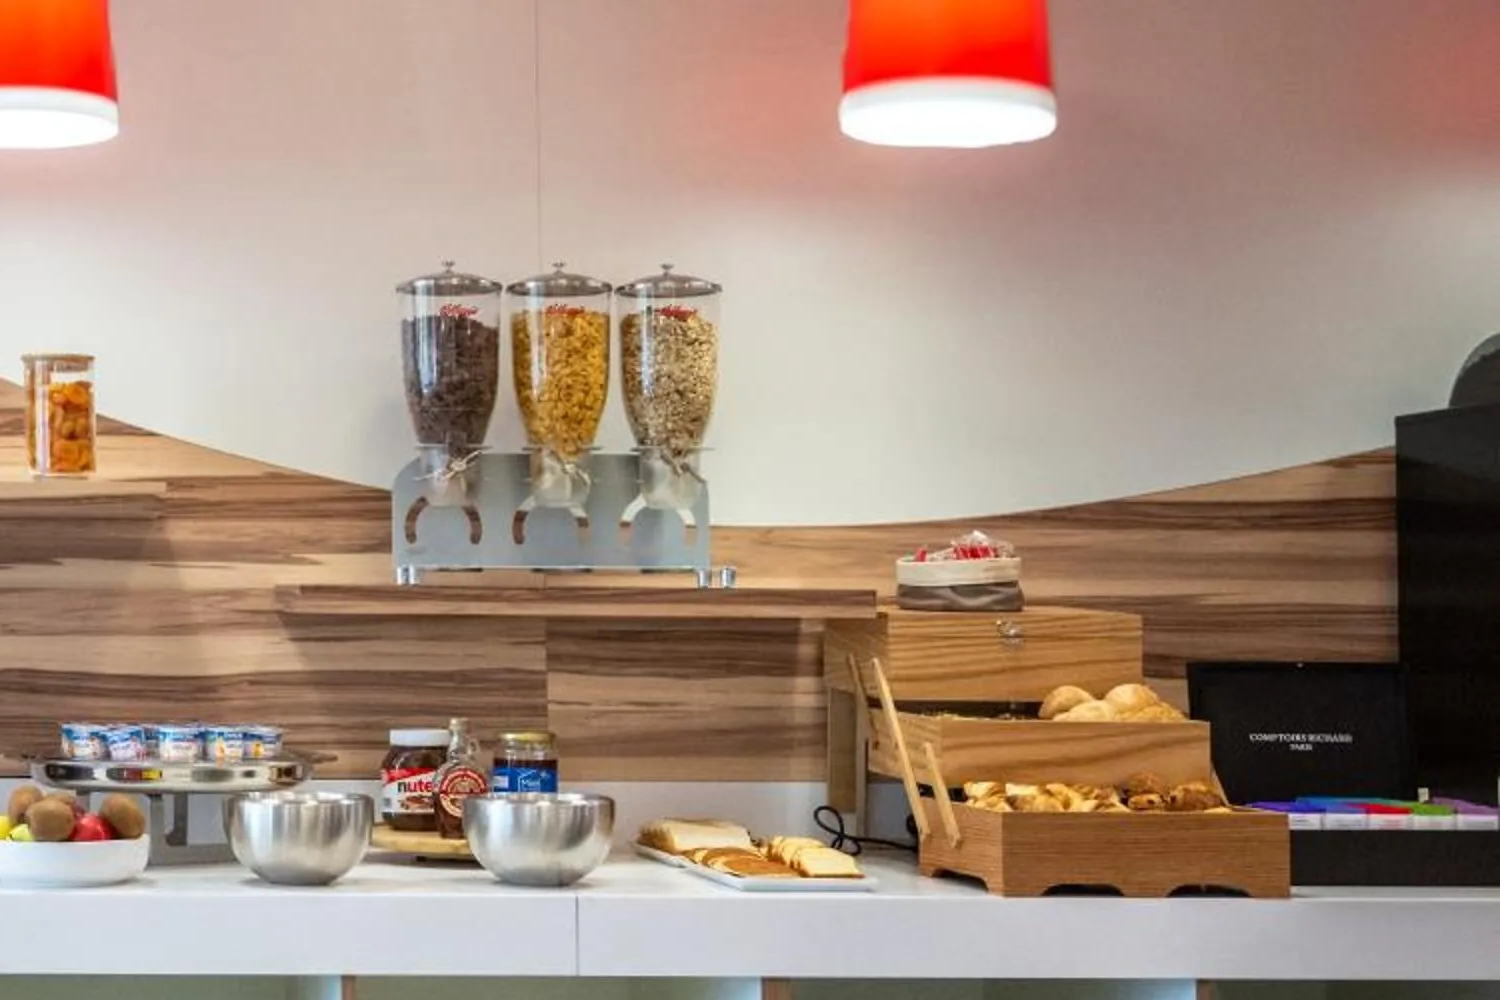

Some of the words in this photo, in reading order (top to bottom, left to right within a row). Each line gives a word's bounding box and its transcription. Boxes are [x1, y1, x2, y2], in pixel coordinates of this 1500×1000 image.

[1249, 733, 1307, 742] COMPTOIRS
[1307, 733, 1353, 743] RICHARD
[397, 778, 434, 792] nute
